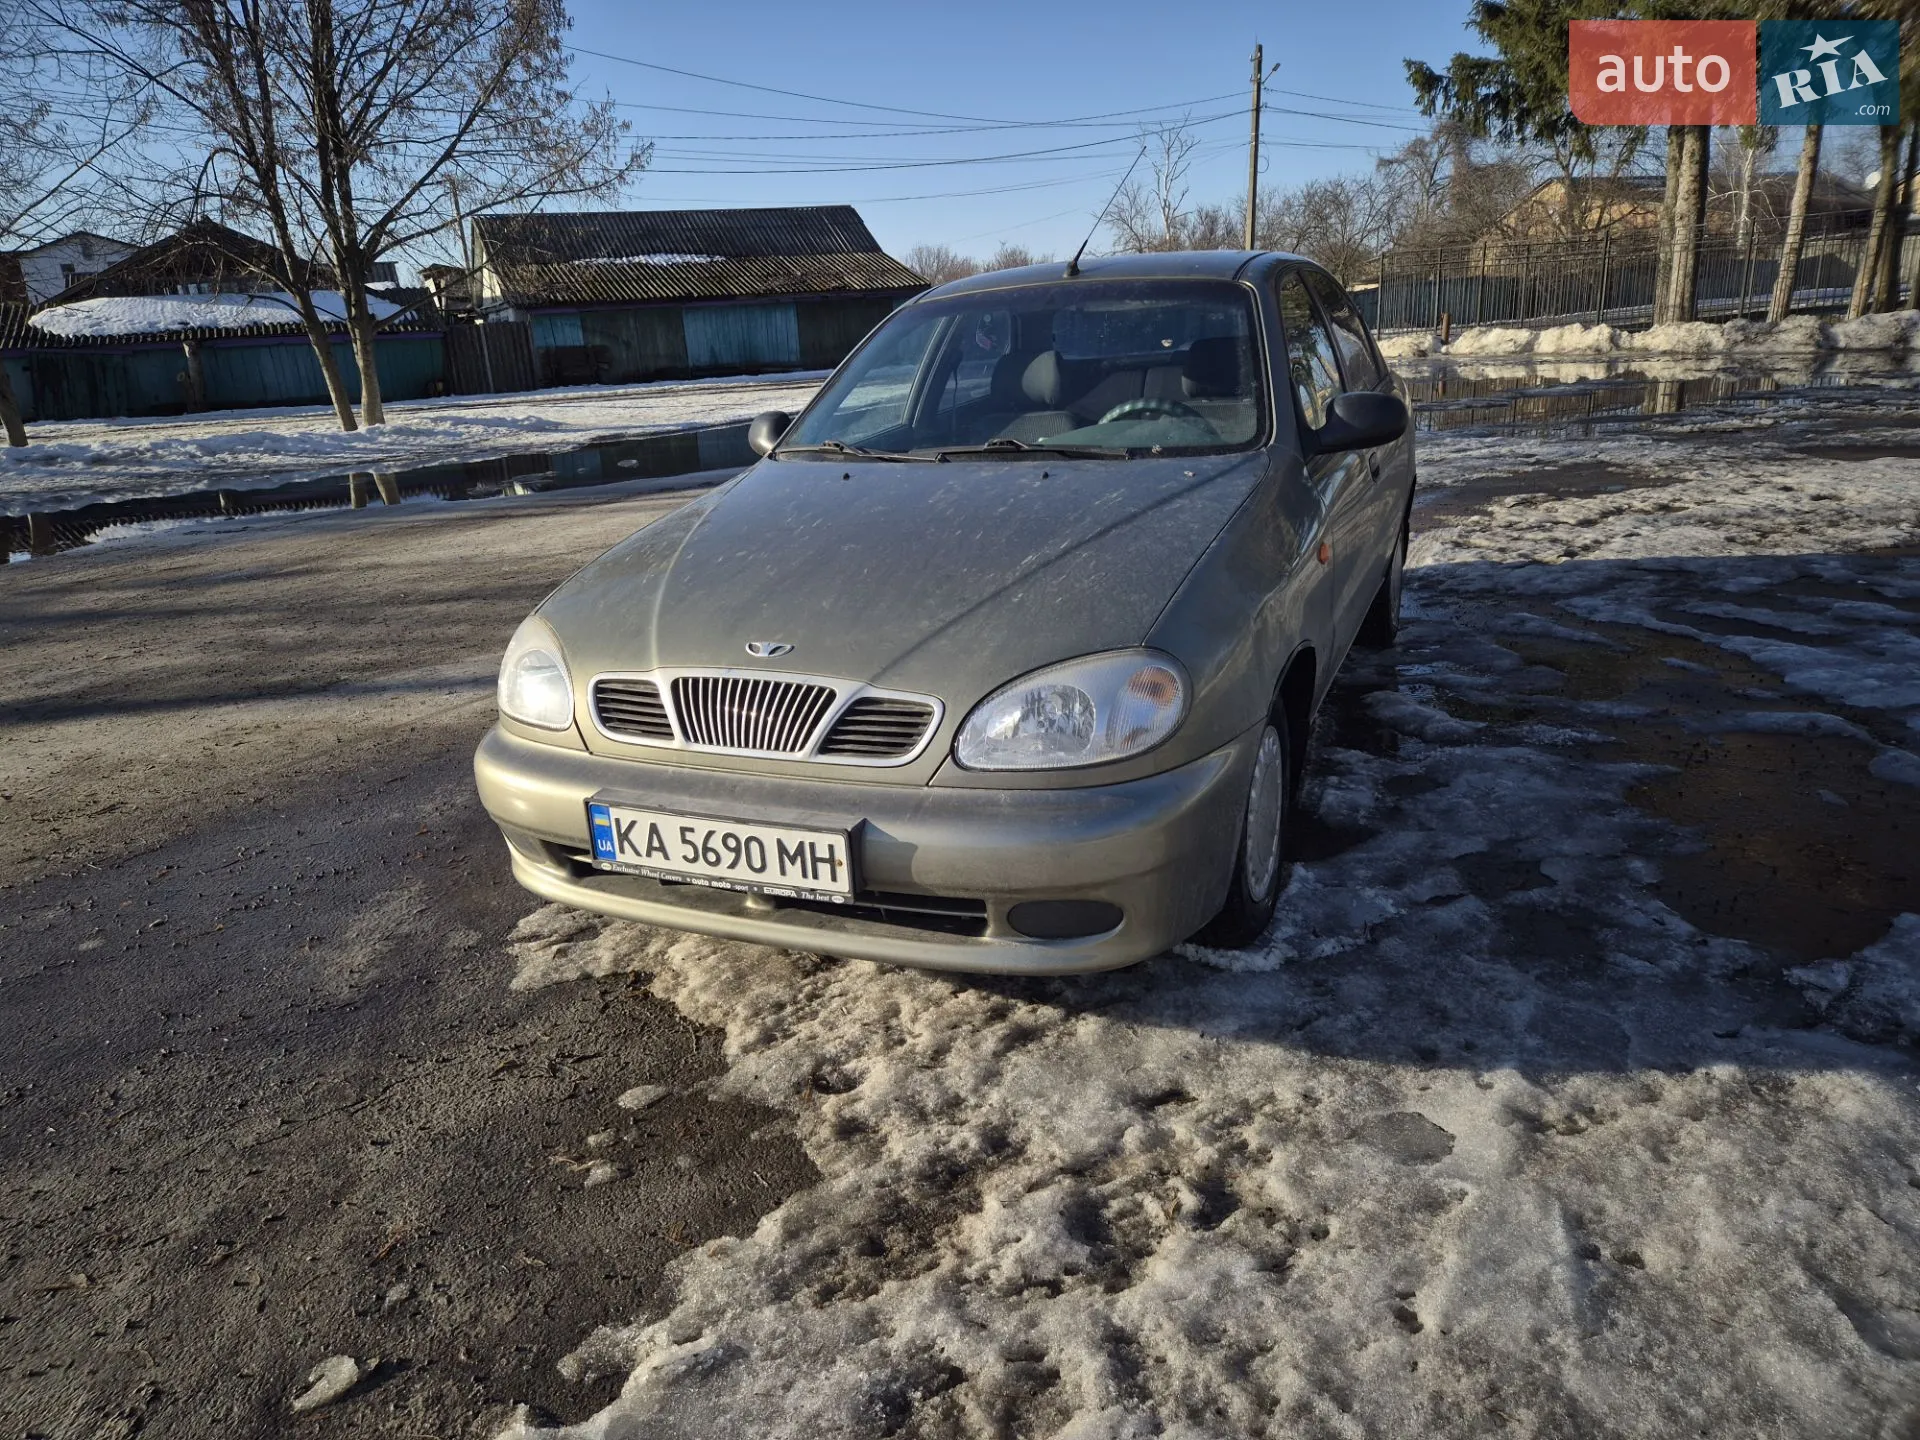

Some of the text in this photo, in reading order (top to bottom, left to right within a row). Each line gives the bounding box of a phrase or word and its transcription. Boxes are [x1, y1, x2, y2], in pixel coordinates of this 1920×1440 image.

[598, 839, 613, 853] UA
[614, 817, 838, 883] KA 5690 MH
